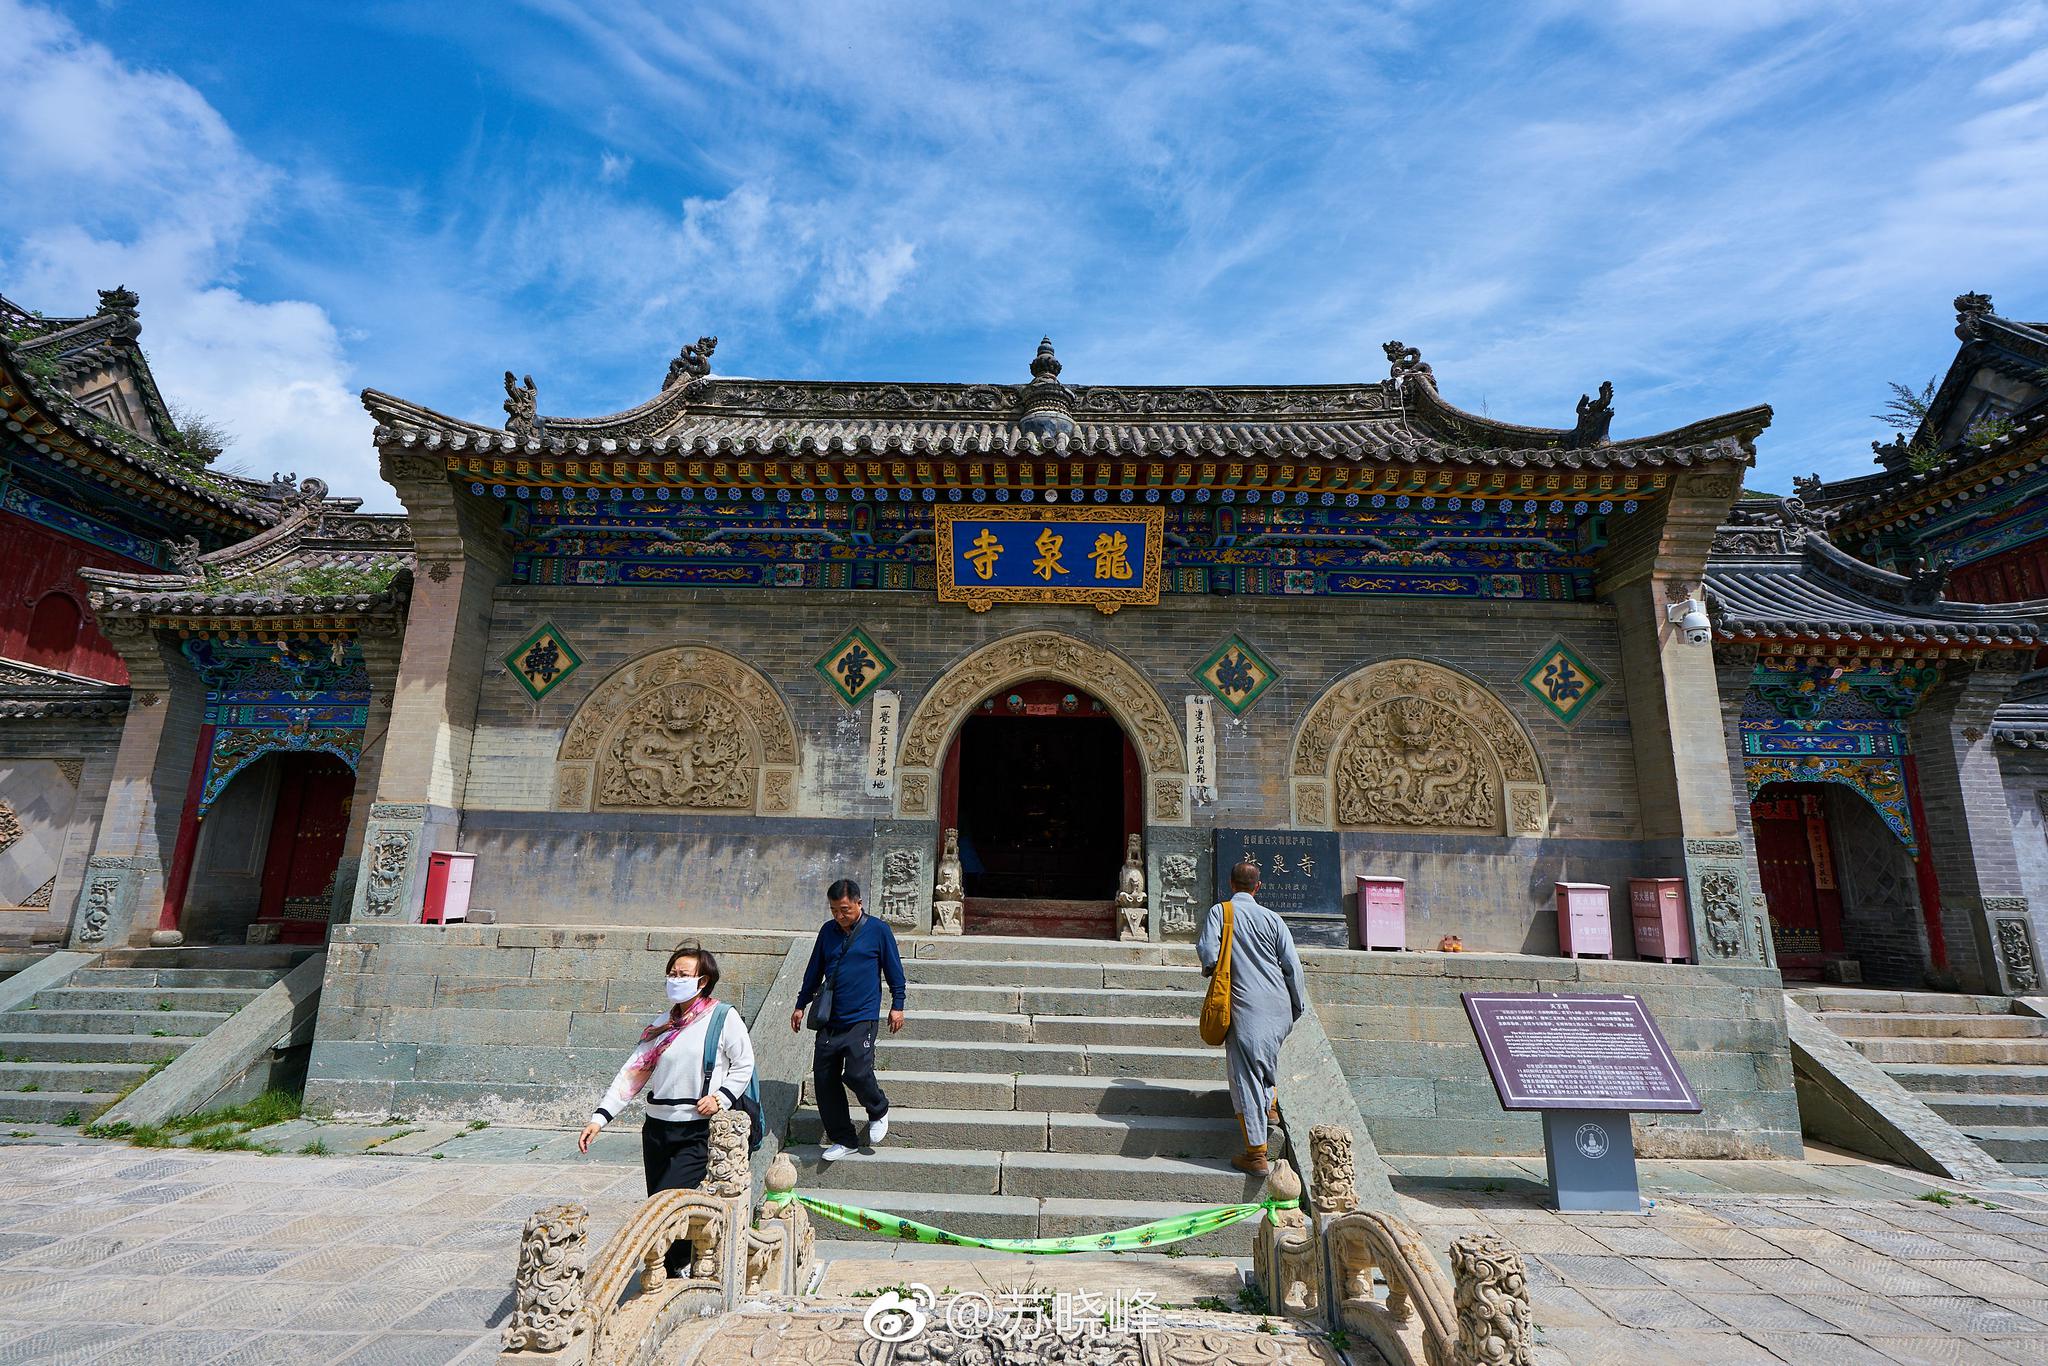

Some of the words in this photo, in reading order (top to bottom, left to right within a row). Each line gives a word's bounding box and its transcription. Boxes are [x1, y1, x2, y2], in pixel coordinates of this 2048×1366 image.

[963, 527, 1133, 581] 龍泉寺
[837, 644, 876, 695] 常
[1215, 652, 1255, 695] 輪
[1543, 659, 1584, 702] 法
